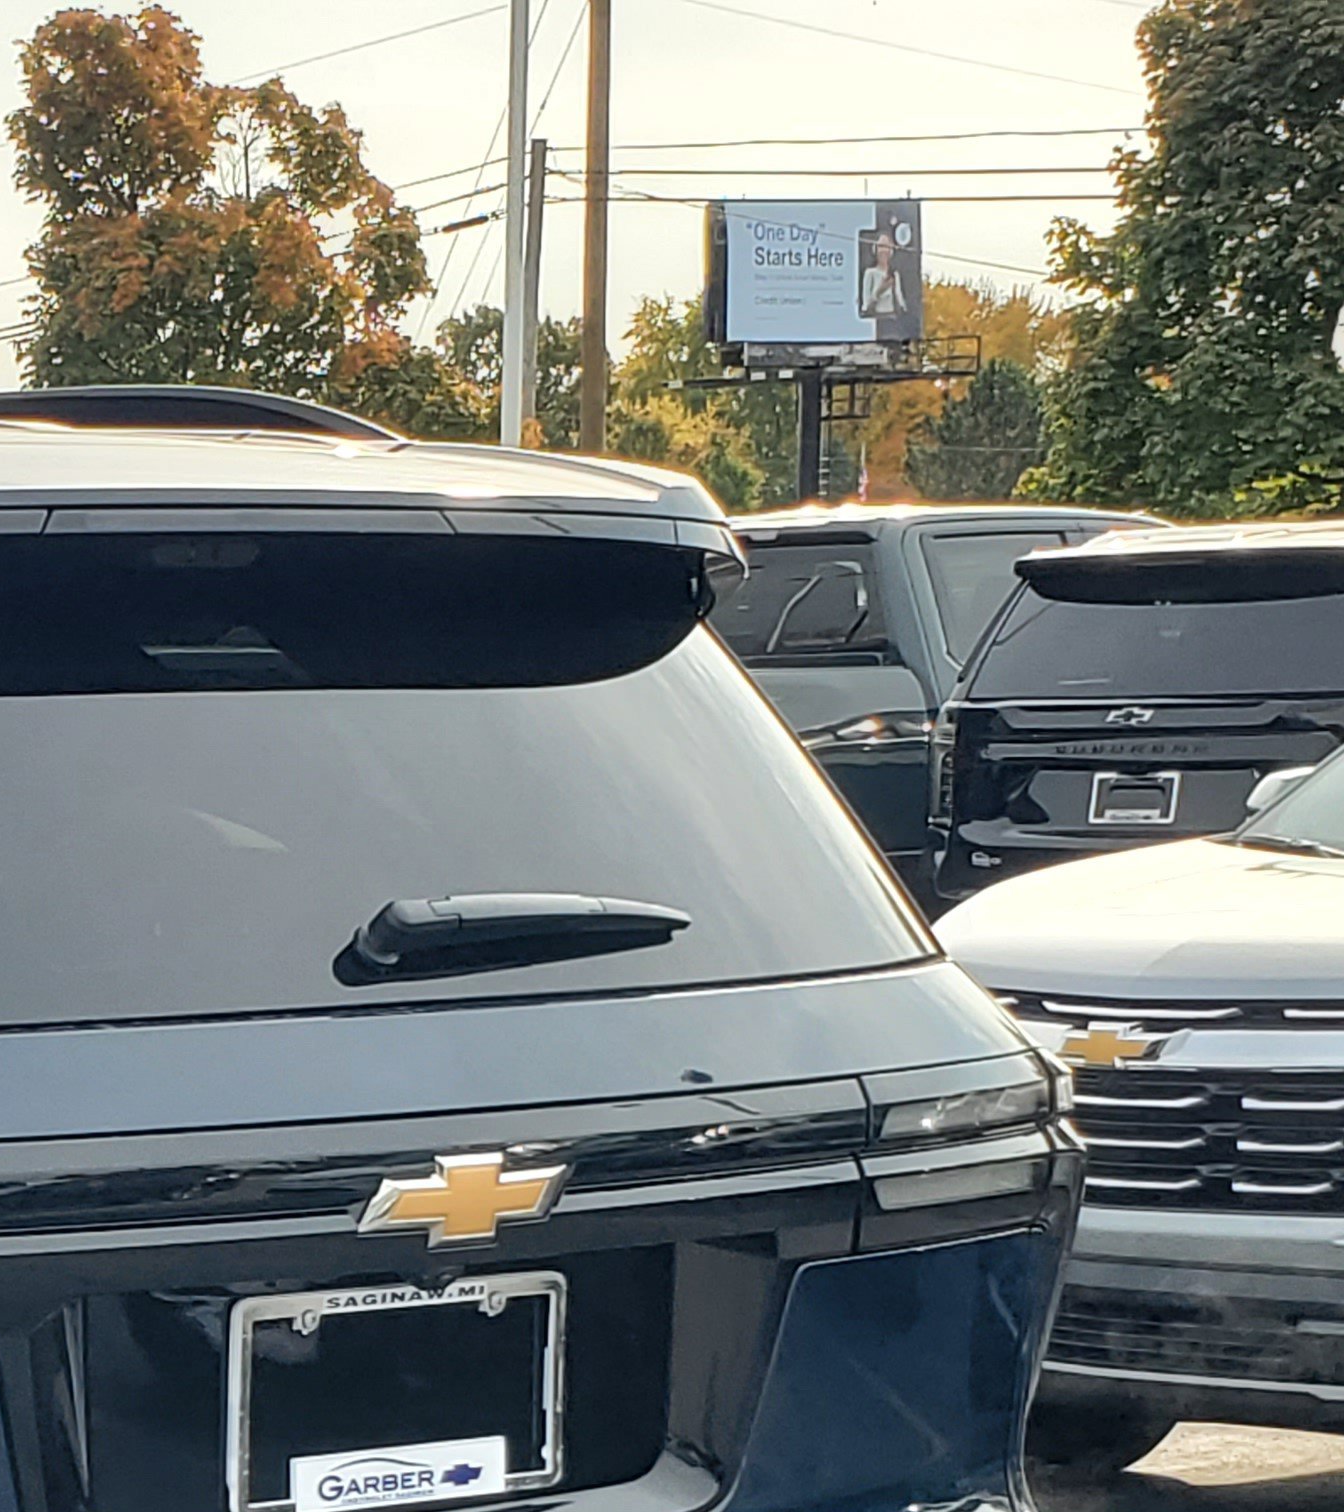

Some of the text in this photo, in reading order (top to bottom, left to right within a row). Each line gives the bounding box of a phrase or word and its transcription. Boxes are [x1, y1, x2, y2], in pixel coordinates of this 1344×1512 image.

[754, 246, 844, 267] Starts Here
[318, 1469, 436, 1501] GARBER
